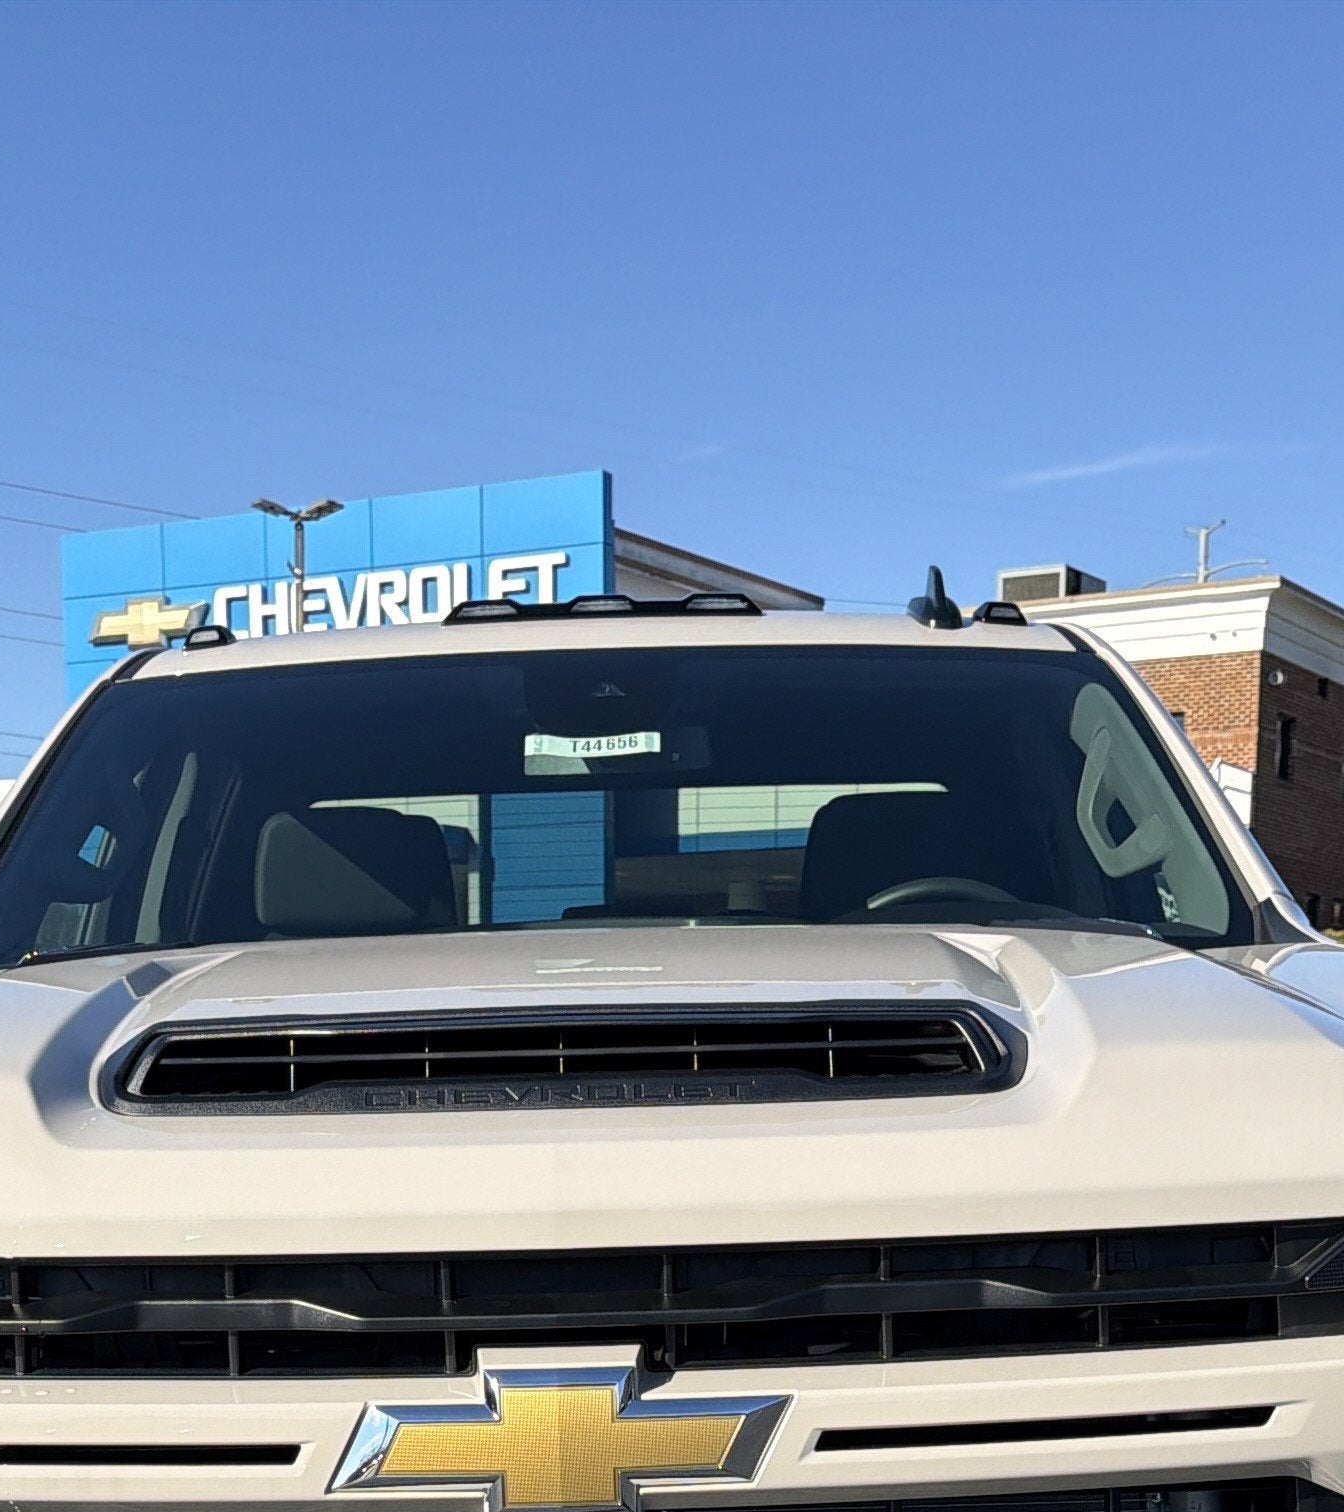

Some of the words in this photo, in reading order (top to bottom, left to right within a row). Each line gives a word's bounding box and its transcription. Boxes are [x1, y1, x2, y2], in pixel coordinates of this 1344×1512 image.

[213, 551, 570, 640] CHEVROLET
[570, 736, 638, 753] T44656
[365, 1081, 755, 1107] CHEVROLET
